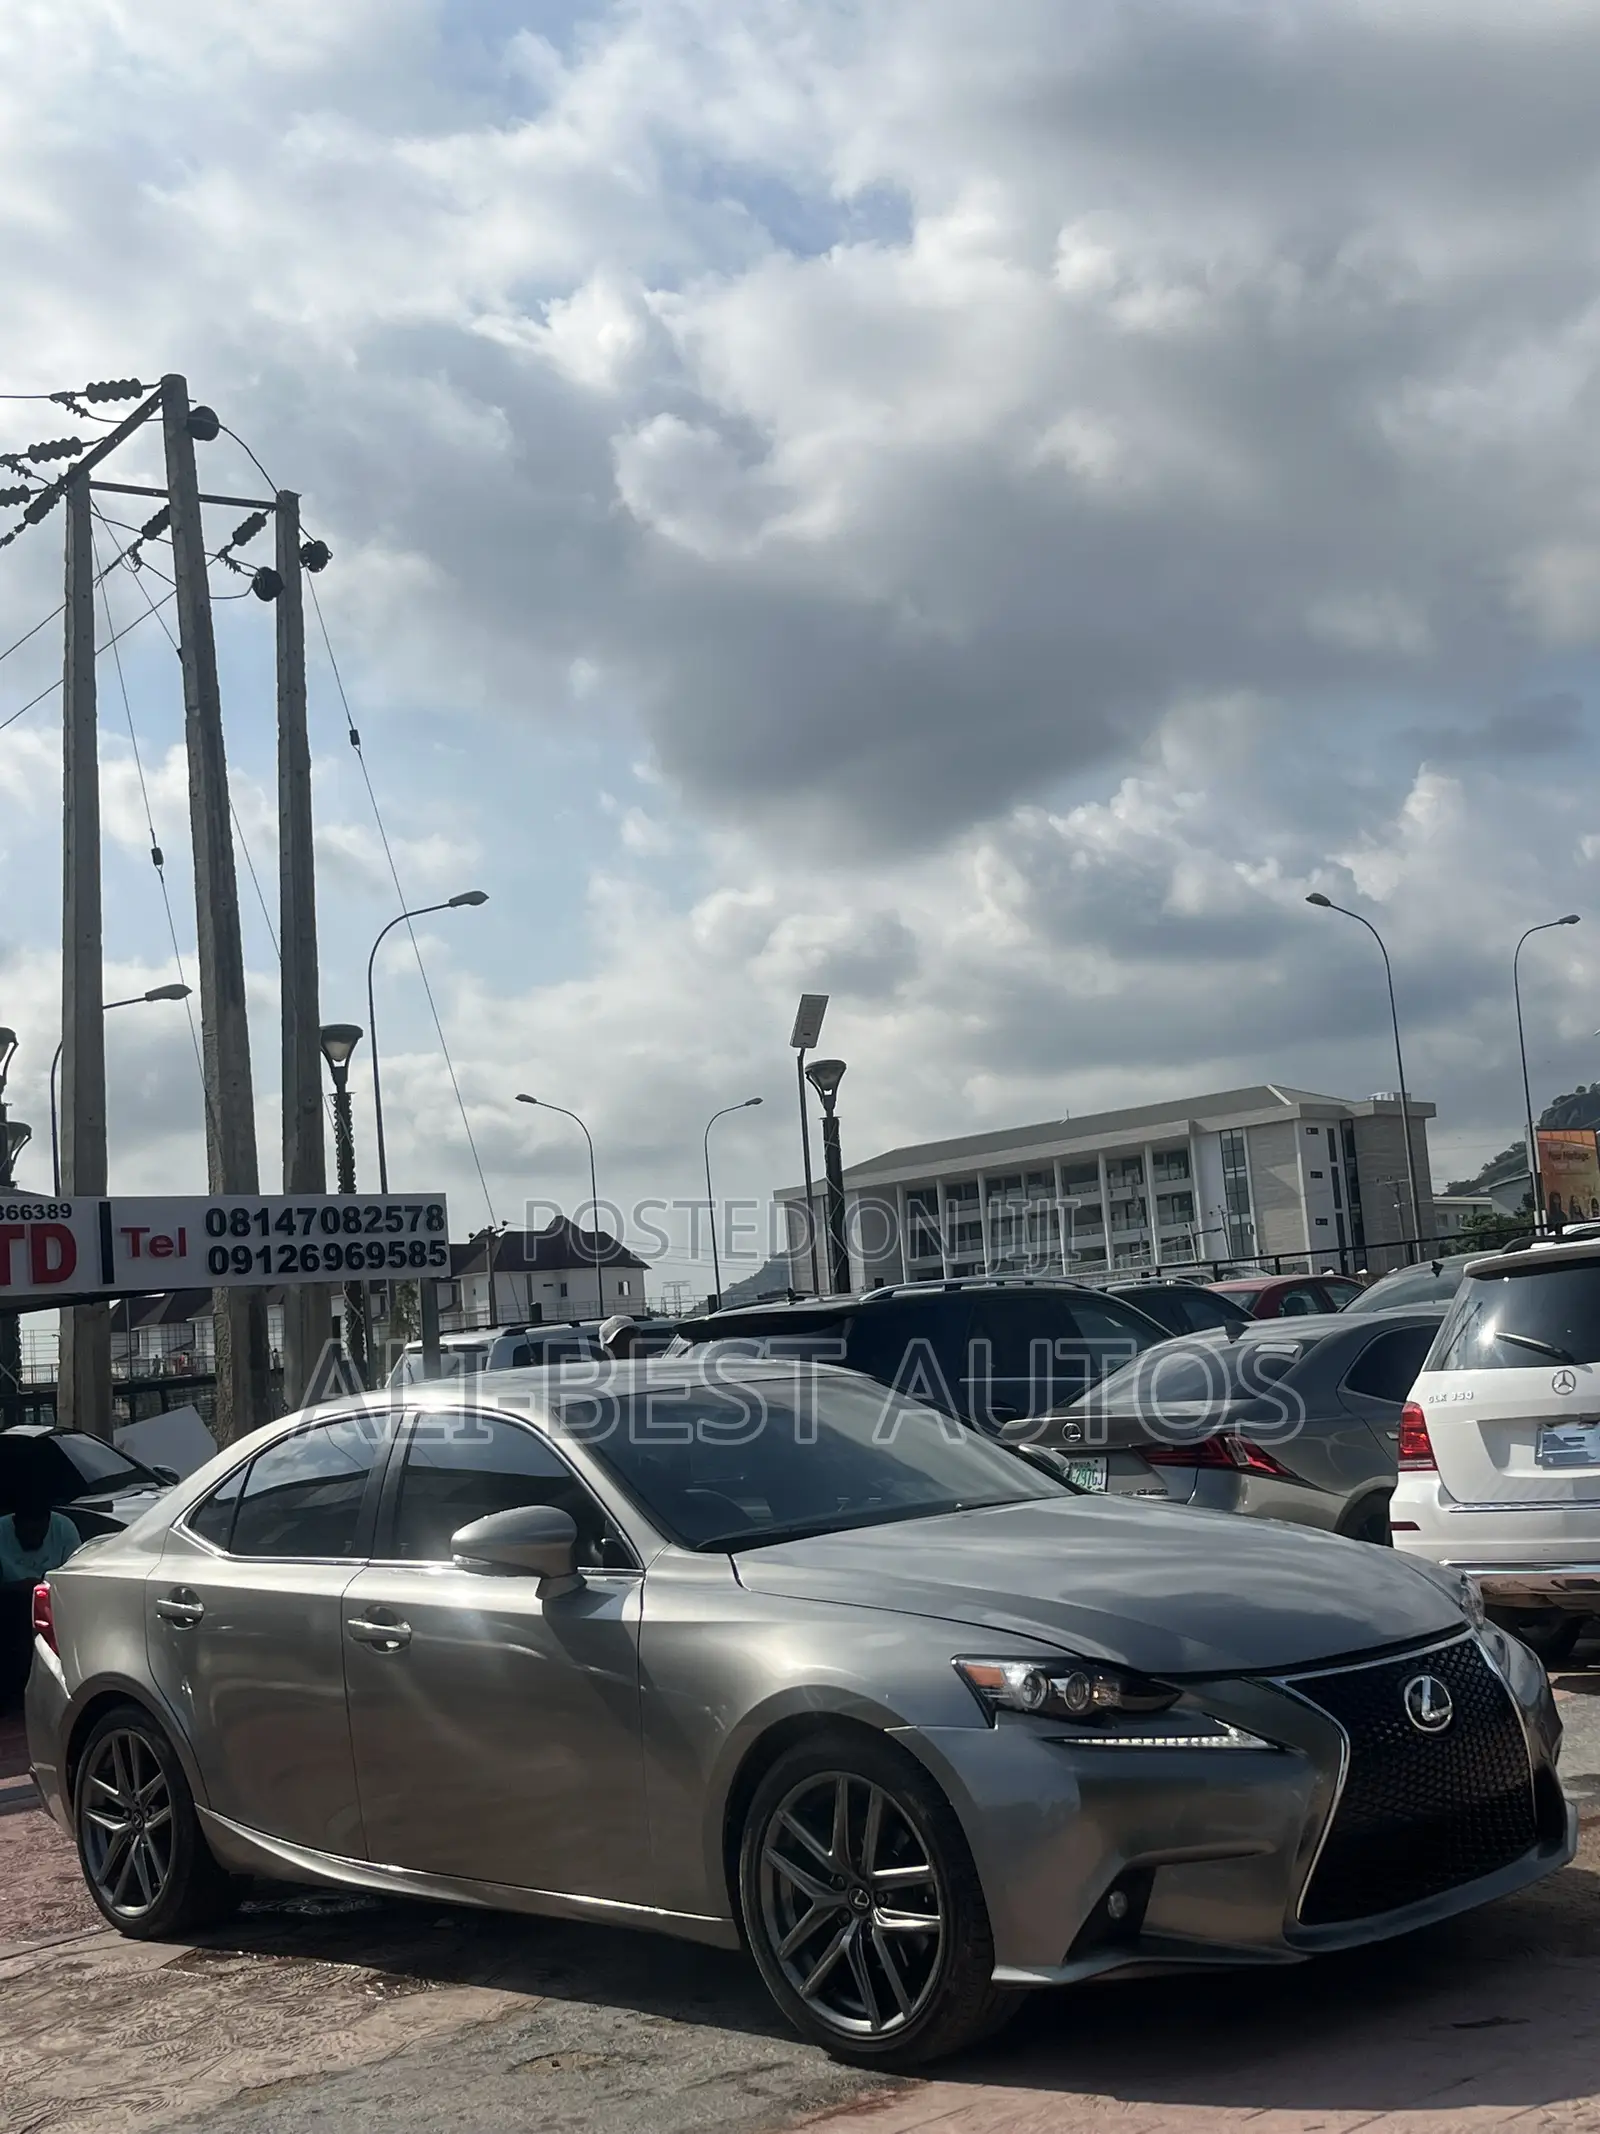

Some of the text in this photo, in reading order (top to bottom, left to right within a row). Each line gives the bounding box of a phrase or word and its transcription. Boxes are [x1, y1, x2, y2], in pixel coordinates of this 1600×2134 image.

[205, 1204, 445, 1238] 08147082578
[120, 1226, 188, 1259] Tel
[207, 1239, 448, 1276] 09126969585
